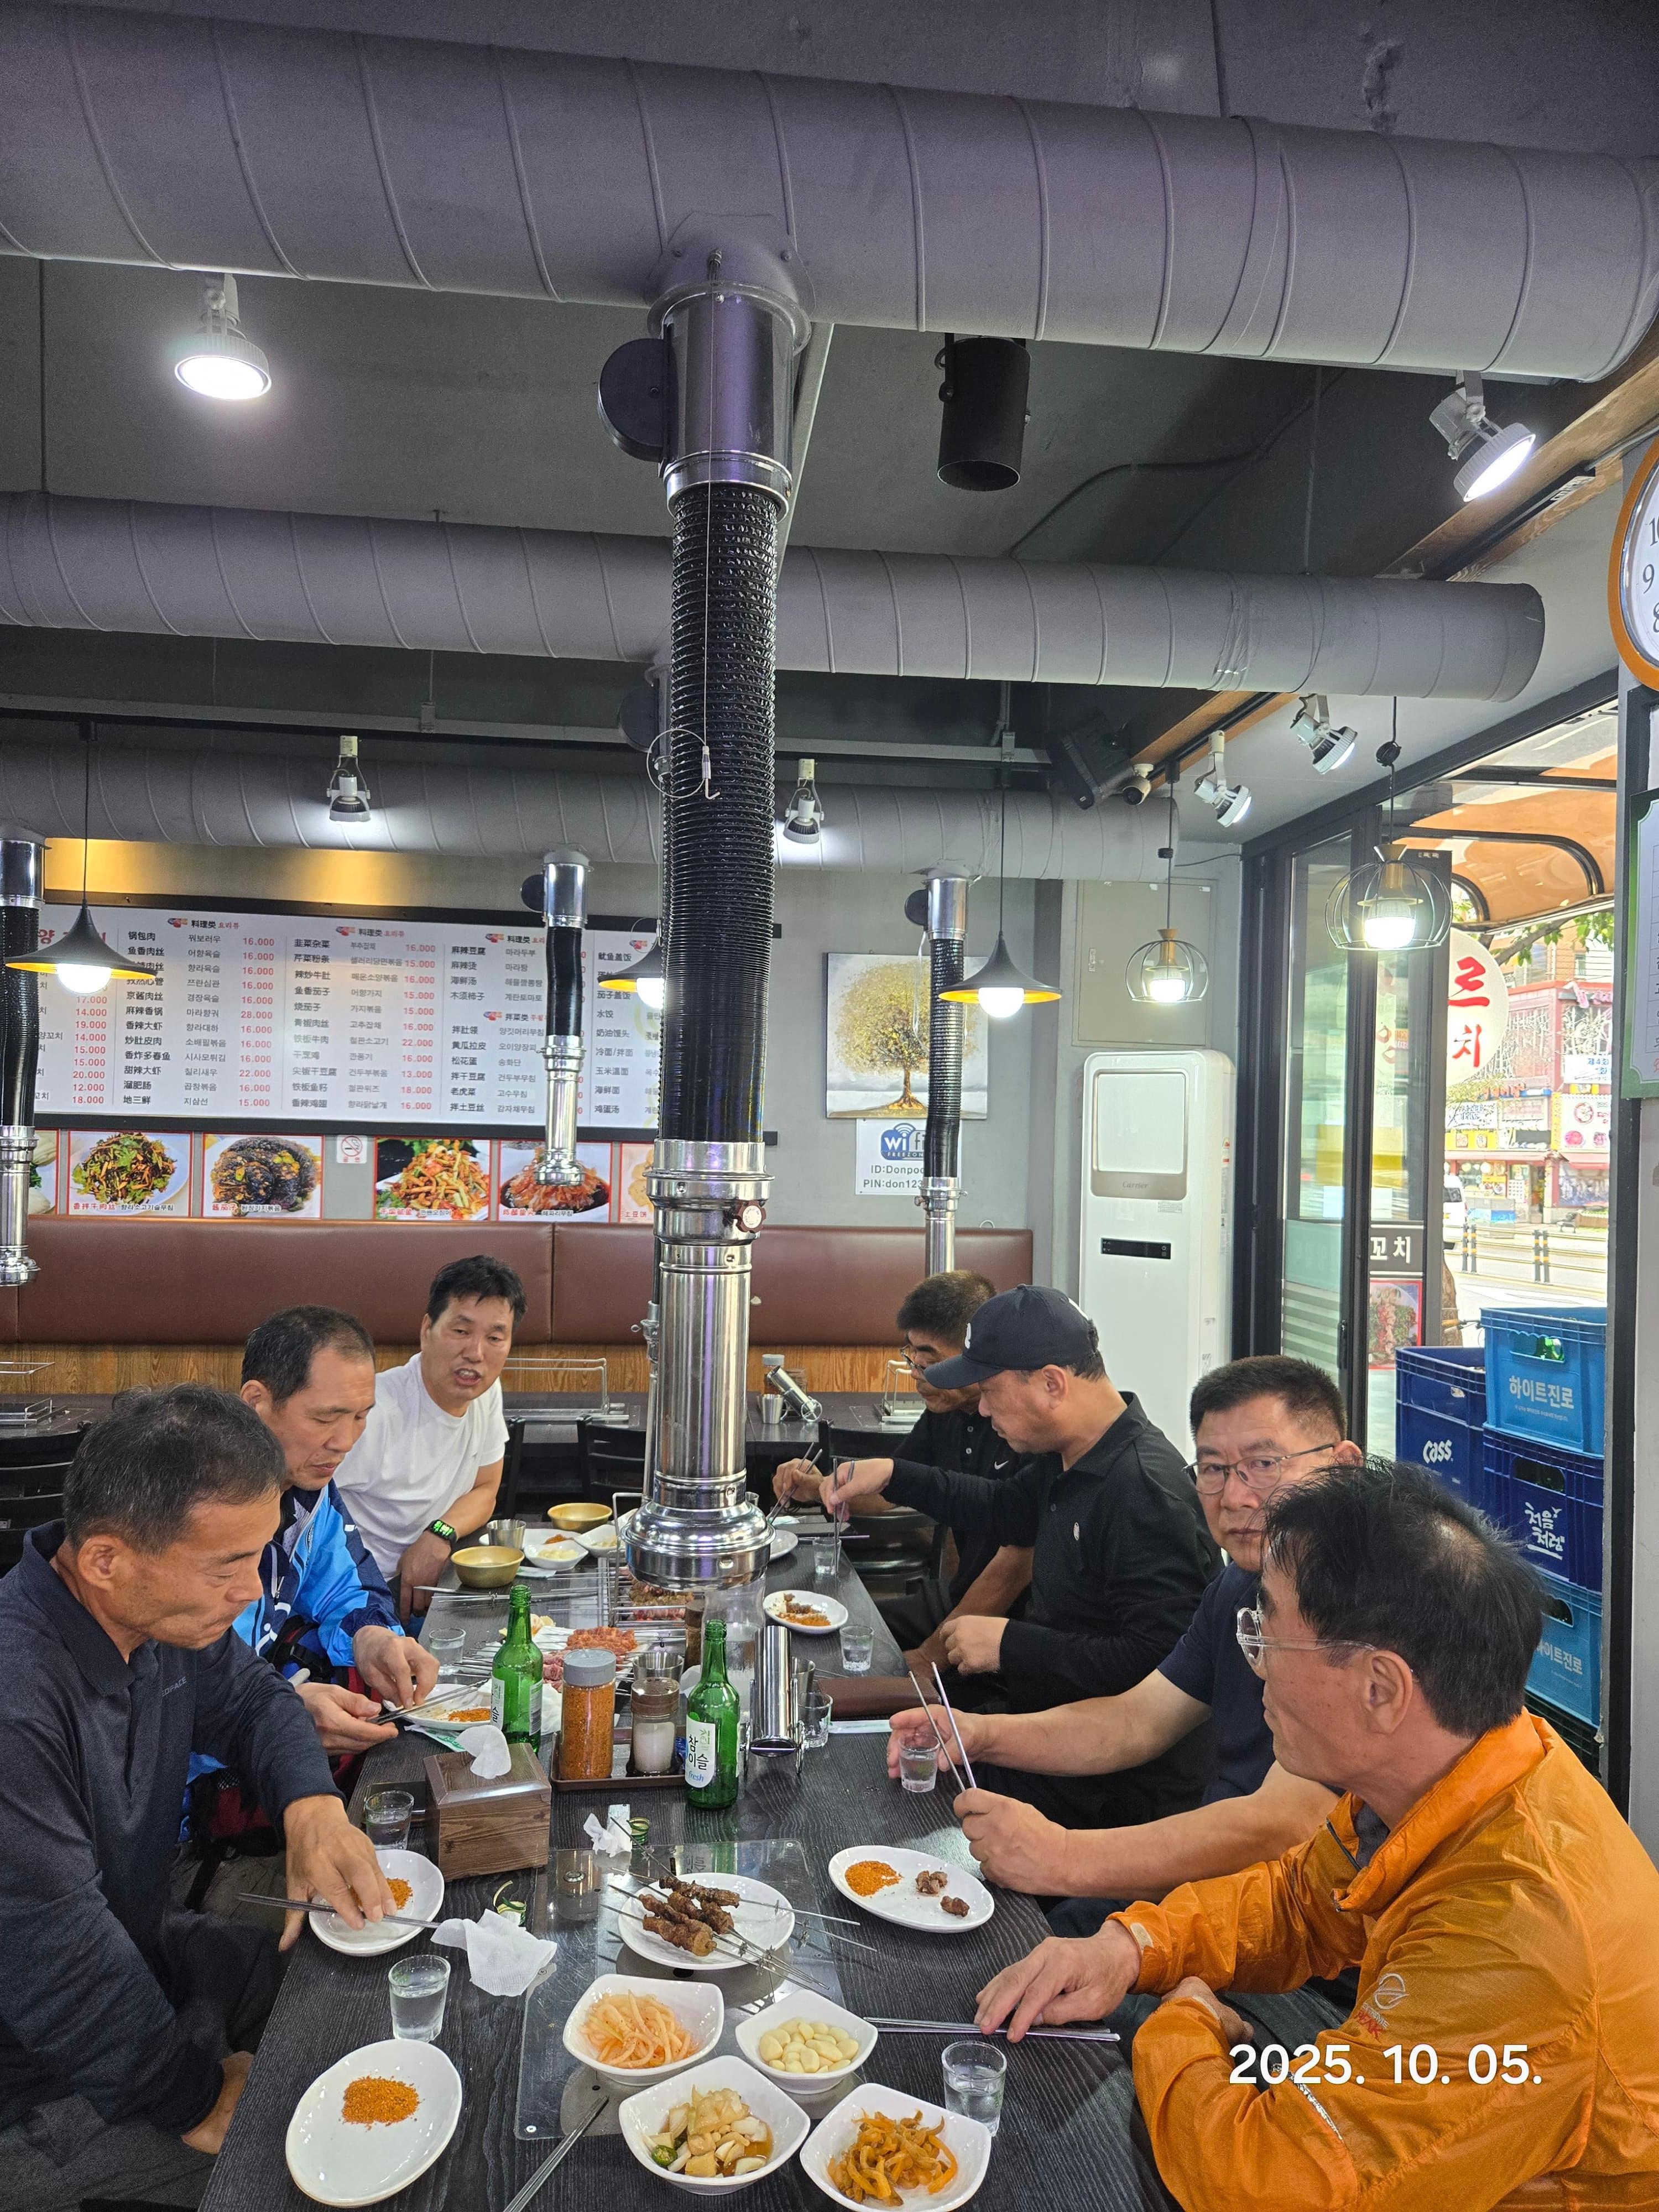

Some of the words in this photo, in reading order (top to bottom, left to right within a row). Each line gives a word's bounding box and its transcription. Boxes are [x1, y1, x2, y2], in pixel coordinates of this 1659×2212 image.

[1642, 564, 1655, 594] 9
[191, 920, 216, 928] 料理类
[358, 928, 383, 937] 料理类
[128, 931, 155, 941] 锅包肉
[243, 937, 274, 946] 16.000
[507, 935, 530, 944] 料理类
[128, 947, 164, 956] 鱼香肉丝
[243, 952, 274, 961] 16.000
[451, 946, 486, 956] 麻辣豆腐
[505, 948, 535, 957] 마라두부
[242, 967, 274, 975] 16.000
[451, 961, 477, 971] 麻辣烫
[505, 963, 528, 972] 마라탕
[451, 976, 477, 985] 海鲜汤
[242, 982, 273, 990] 16.000
[127, 991, 163, 1001] 京酱肉丝
[242, 997, 273, 1005] 16.000
[505, 993, 542, 1001] 계란토마토
[126, 1006, 163, 1015] 麻辣香锅
[294, 1002, 321, 1011] 烧茄子
[505, 1013, 529, 1021] 拌菜类
[597, 1010, 614, 1018] 水饺
[126, 1021, 163, 1031] 香辣大虾
[186, 1024, 218, 1032] 향라대하
[125, 1036, 161, 1045] 炒肚皮肉
[241, 1040, 272, 1048] 16.000
[452, 1041, 487, 1050] 黄瓜拉皮
[1452, 1024, 1482, 1067] 치
[125, 1051, 171, 1061] 香炸多春鱼
[185, 1053, 226, 1062] 시사모튀김
[596, 1047, 633, 1057] 冷面/拌面
[451, 1056, 477, 1065] 松花蛋
[124, 1066, 161, 1075] 甜辣大虾
[185, 1068, 217, 1077] 칠리새우
[451, 1072, 486, 1081] 拌干豆腐
[595, 1067, 629, 1076] 玉米温面
[123, 1081, 152, 1090] 溜肥肠
[594, 1086, 620, 1094] 海鲜面
[451, 1087, 476, 1096] 老虎菜
[123, 1095, 151, 1104] 地三鲜
[184, 1098, 208, 1106] 지삼선
[450, 1103, 485, 1112] 拌土豆丝
[594, 1105, 619, 1114] 鸡蛋汤
[1370, 1236, 1410, 1263] 꼬치
[1509, 1375, 1574, 1409] 하이트진로
[1525, 1502, 1556, 1529] 처음
[1532, 1531, 1565, 1552] 처럼
[492, 1707, 500, 1723] 슬
[688, 1734, 698, 1752] 참
[688, 1754, 709, 1771] 이슬
[688, 1771, 704, 1782] fresh
